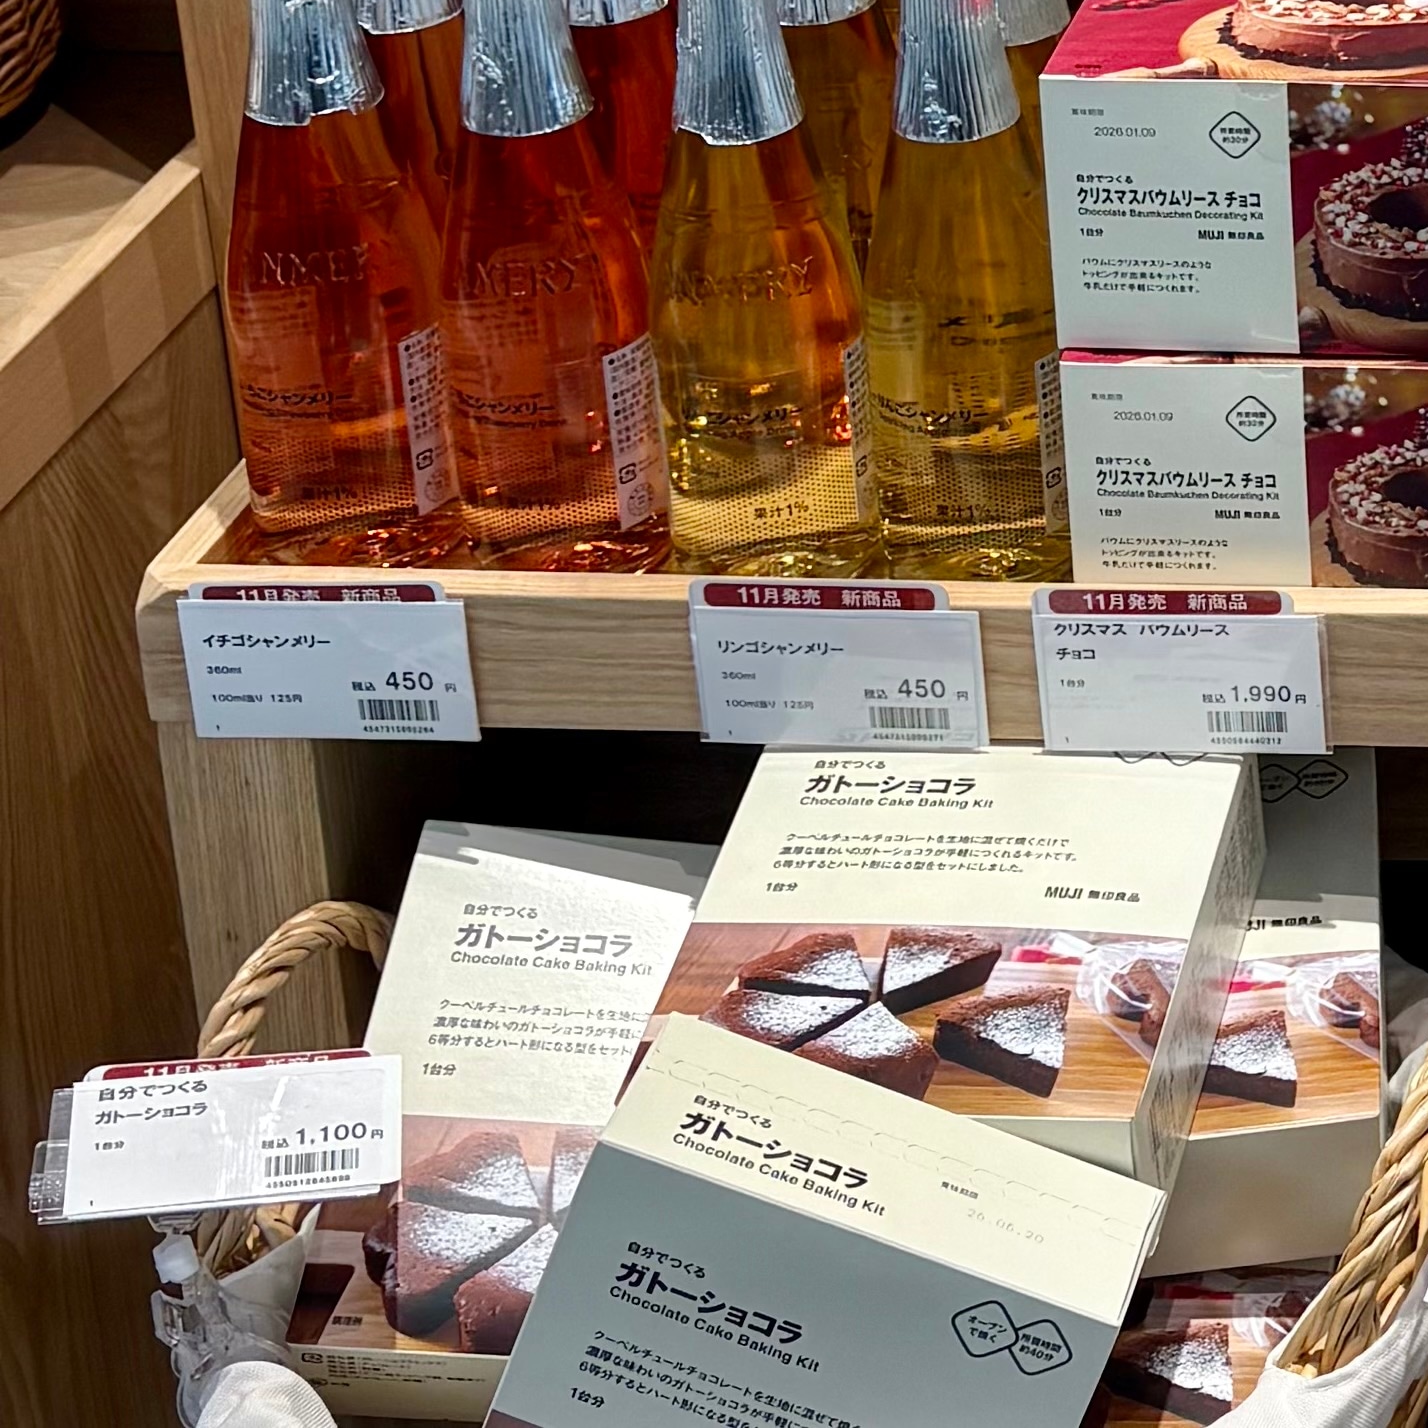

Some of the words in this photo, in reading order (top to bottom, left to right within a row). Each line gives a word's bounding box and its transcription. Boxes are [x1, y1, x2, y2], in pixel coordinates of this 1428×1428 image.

[1094, 125, 1156, 140] 2026.01.09
[1077, 188, 1219, 210] クリスマスバウムリース
[1096, 468, 1238, 490] クリスマスバウムリース
[1081, 591, 1168, 612] 11月発売
[1187, 593, 1249, 612] 新商品
[1054, 622, 1127, 638] クリスマス
[1140, 622, 1231, 638] バウムリース
[202, 632, 330, 651] イチゴシャンメリー
[717, 639, 844, 656] リンゴシャンメリー
[385, 670, 434, 692] 450
[897, 678, 947, 699] 450
[805, 773, 977, 797] ガトーショコラ
[455, 923, 634, 959] ガトーショコラ
[98, 1079, 208, 1103] 自分でつくる
[94, 1101, 209, 1127] ガトーショコラ
[679, 1109, 870, 1191] ガトーショコラ
[615, 1260, 804, 1345] ガトーショコラ
